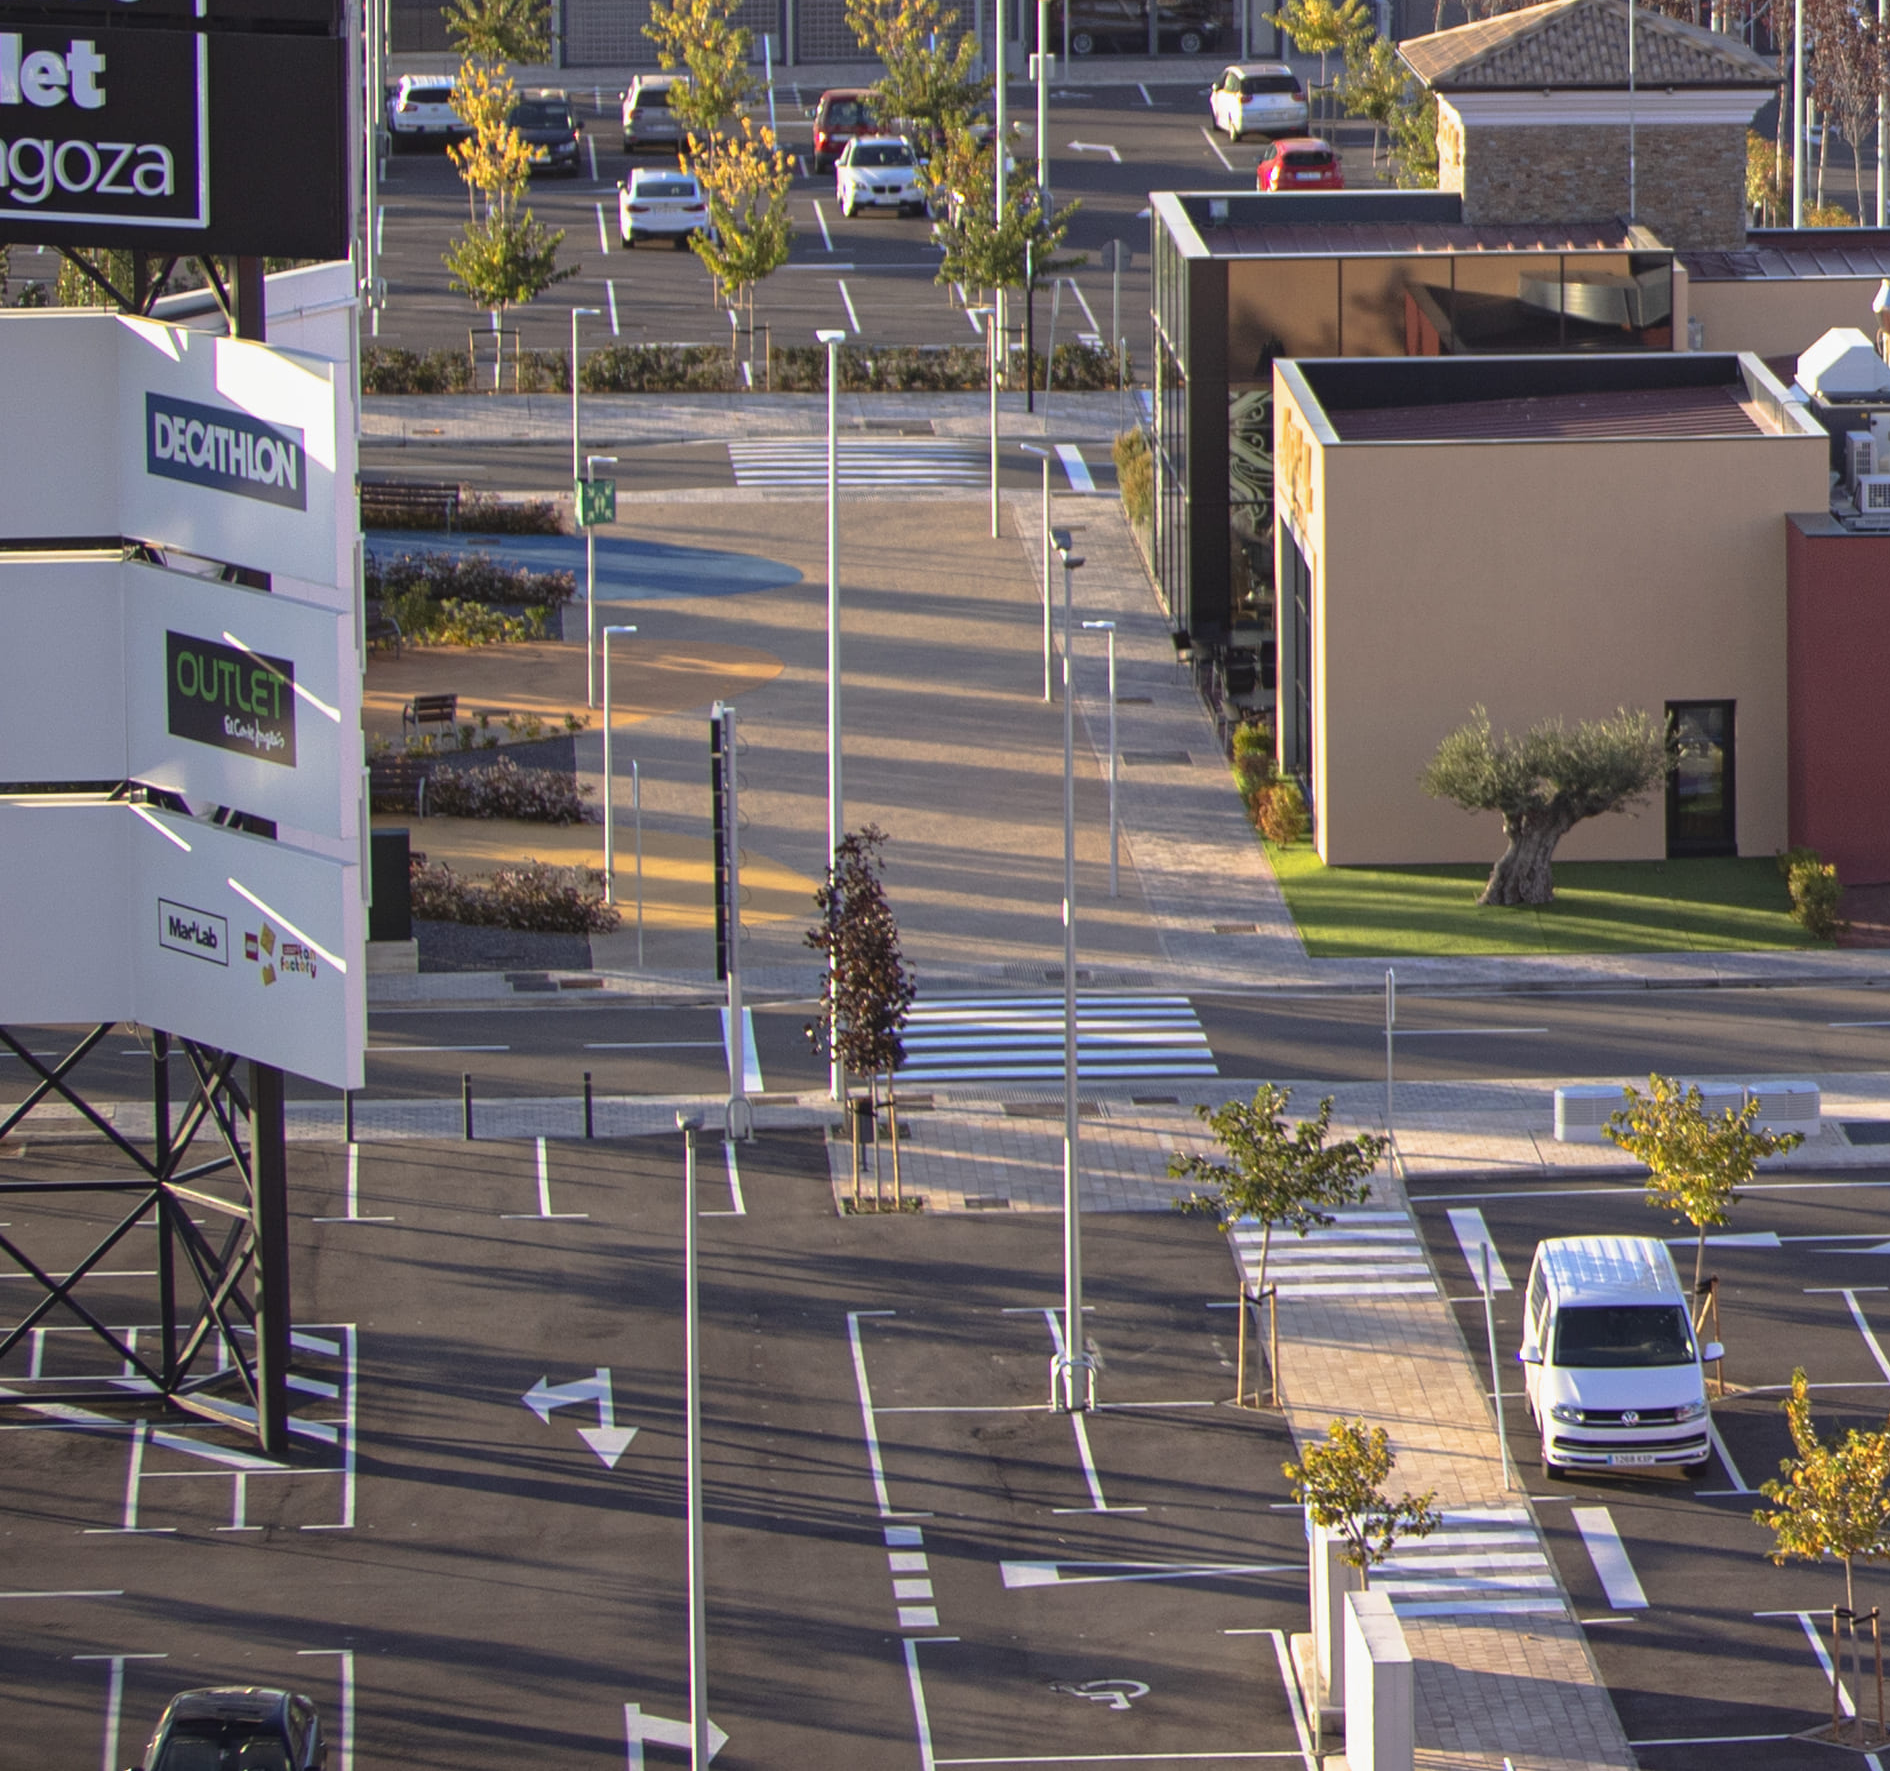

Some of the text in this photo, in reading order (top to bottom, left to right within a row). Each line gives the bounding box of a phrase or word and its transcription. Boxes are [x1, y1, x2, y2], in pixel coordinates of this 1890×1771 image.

[154, 411, 297, 490] DECATHLON
[176, 650, 285, 720] OUTLET
[280, 956, 317, 979] factory
